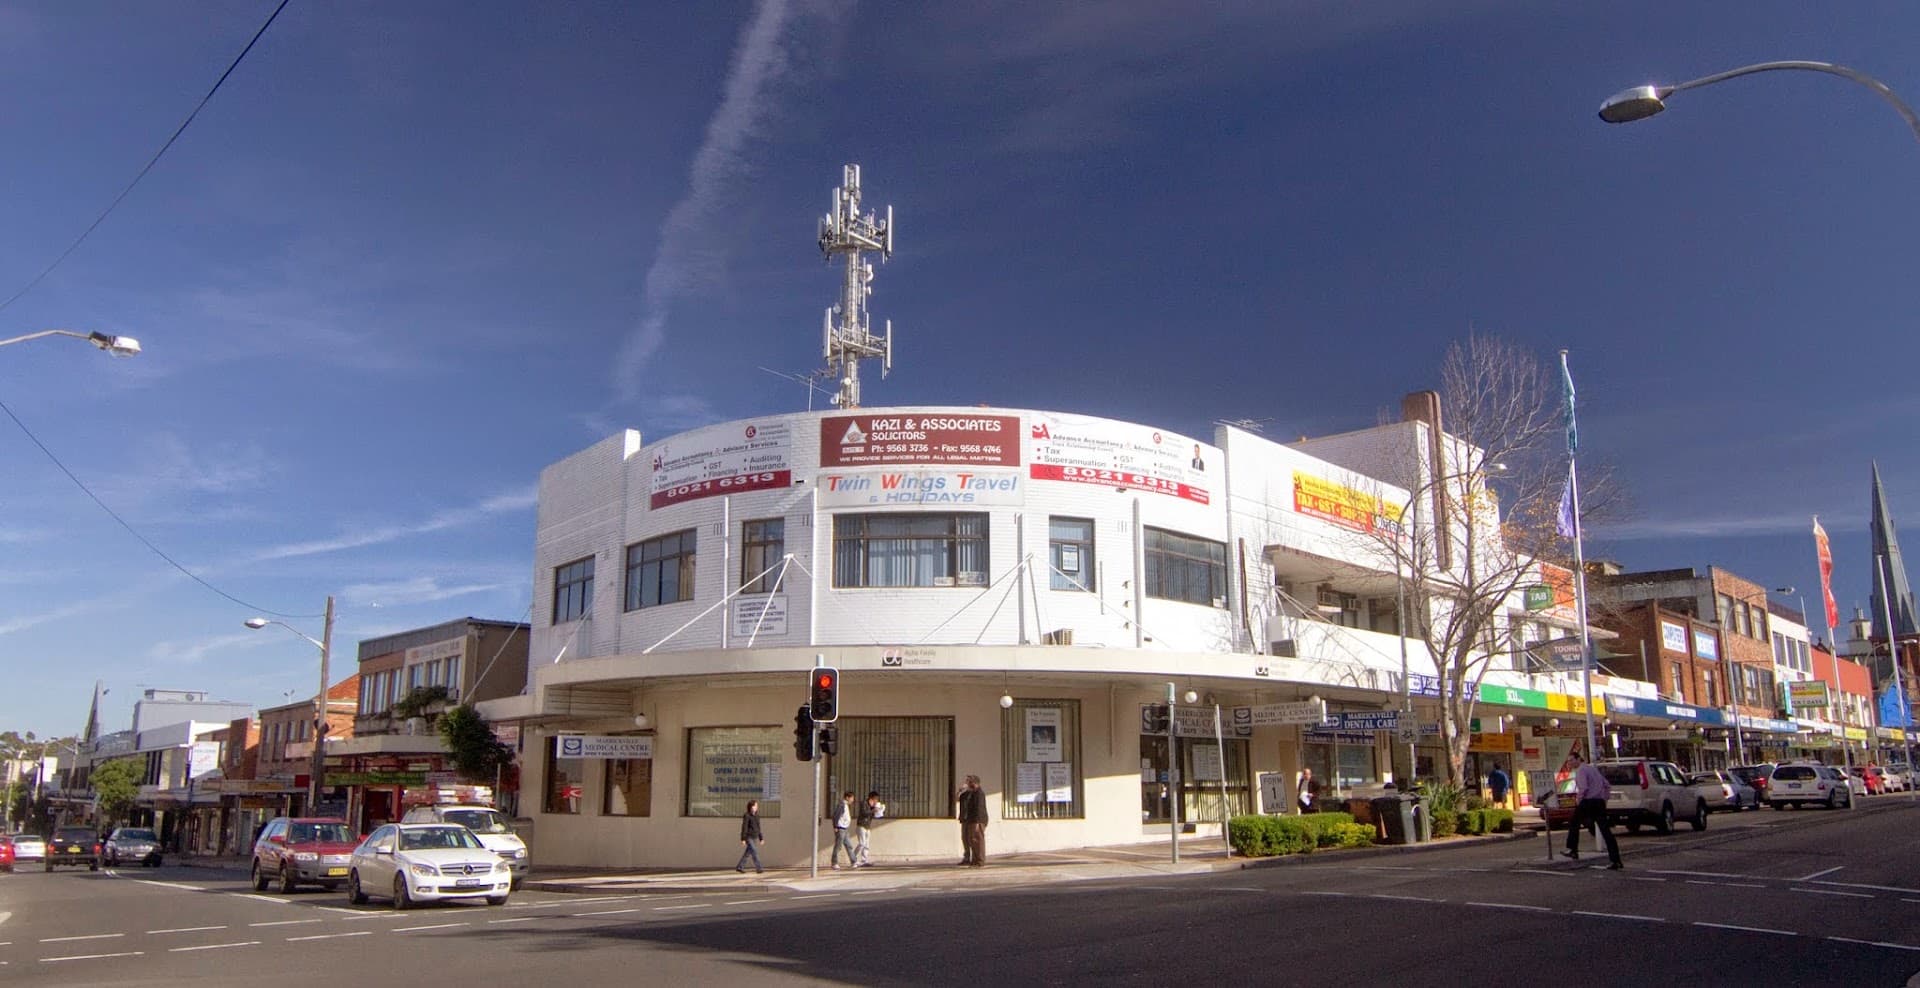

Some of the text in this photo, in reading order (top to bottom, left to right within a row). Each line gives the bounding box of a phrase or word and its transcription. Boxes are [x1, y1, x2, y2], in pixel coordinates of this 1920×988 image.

[871, 418, 1001, 432] KAZI & ASSOCIATES
[871, 431, 926, 441] SOLICITORS
[723, 444, 748, 453] Advisory
[750, 440, 778, 449] Services
[871, 444, 884, 453] Ph:
[887, 444, 907, 452] 9568
[941, 444, 957, 453] Fax:
[960, 445, 980, 453] 9568
[1044, 446, 1060, 455] Tax
[750, 455, 782, 464] Auditing
[1044, 455, 1107, 467] Superannuation
[709, 461, 722, 470] GST
[749, 462, 787, 471] Insurance
[828, 473, 1017, 492] Twin Wings Travel
[1063, 466, 1123, 481] 8021
[1132, 474, 1178, 490] 6313
[667, 472, 775, 497] 8021 6313
[886, 492, 975, 503] HOLIDAYS
[1254, 709, 1286, 719] MEDICAL
[1290, 707, 1319, 717] CENTRE
[1348, 711, 1394, 720] MARRICKVILLE
[1345, 720, 1375, 729] DENTAL
[1377, 719, 1398, 728] CARE
[706, 756, 766, 764] MEDICAL CENTRE
[1272, 786, 1277, 799] 1
